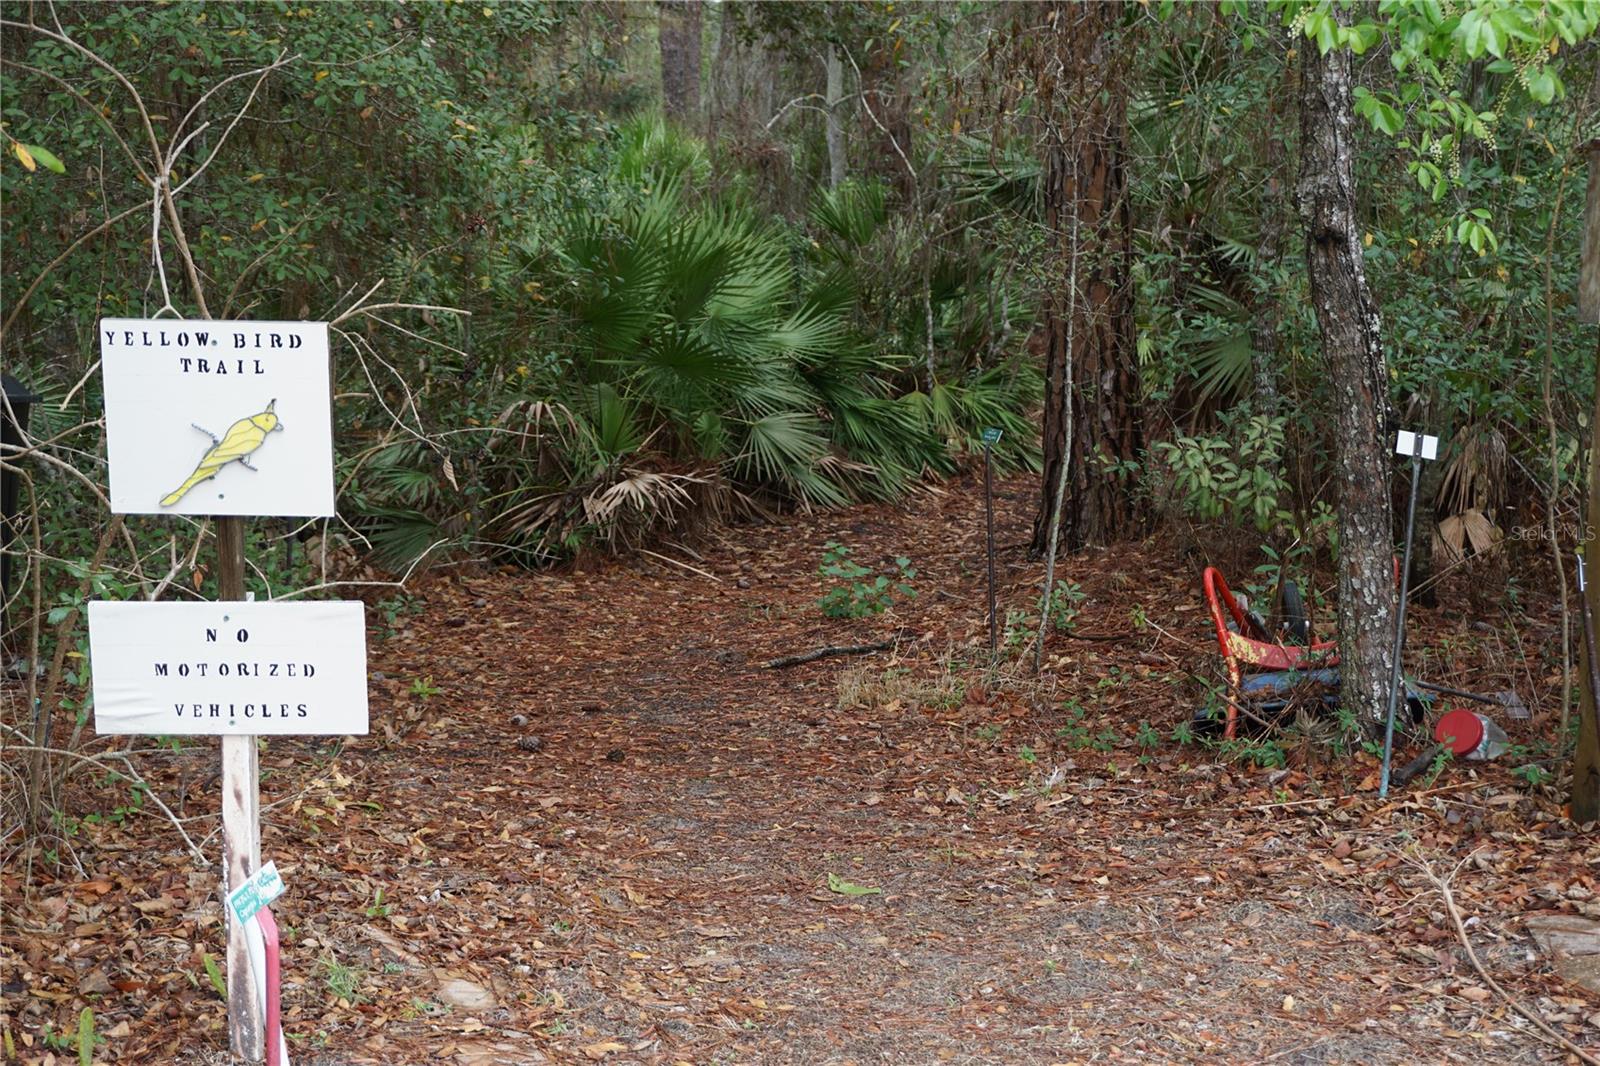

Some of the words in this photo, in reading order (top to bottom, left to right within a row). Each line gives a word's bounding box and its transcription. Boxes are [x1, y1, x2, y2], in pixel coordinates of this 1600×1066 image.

[105, 331, 209, 347] YELLOW
[233, 333, 302, 349] BIRD
[180, 357, 264, 375] TRAIL
[155, 662, 315, 677] MOTORIZED
[175, 704, 307, 718] VEHICLES
